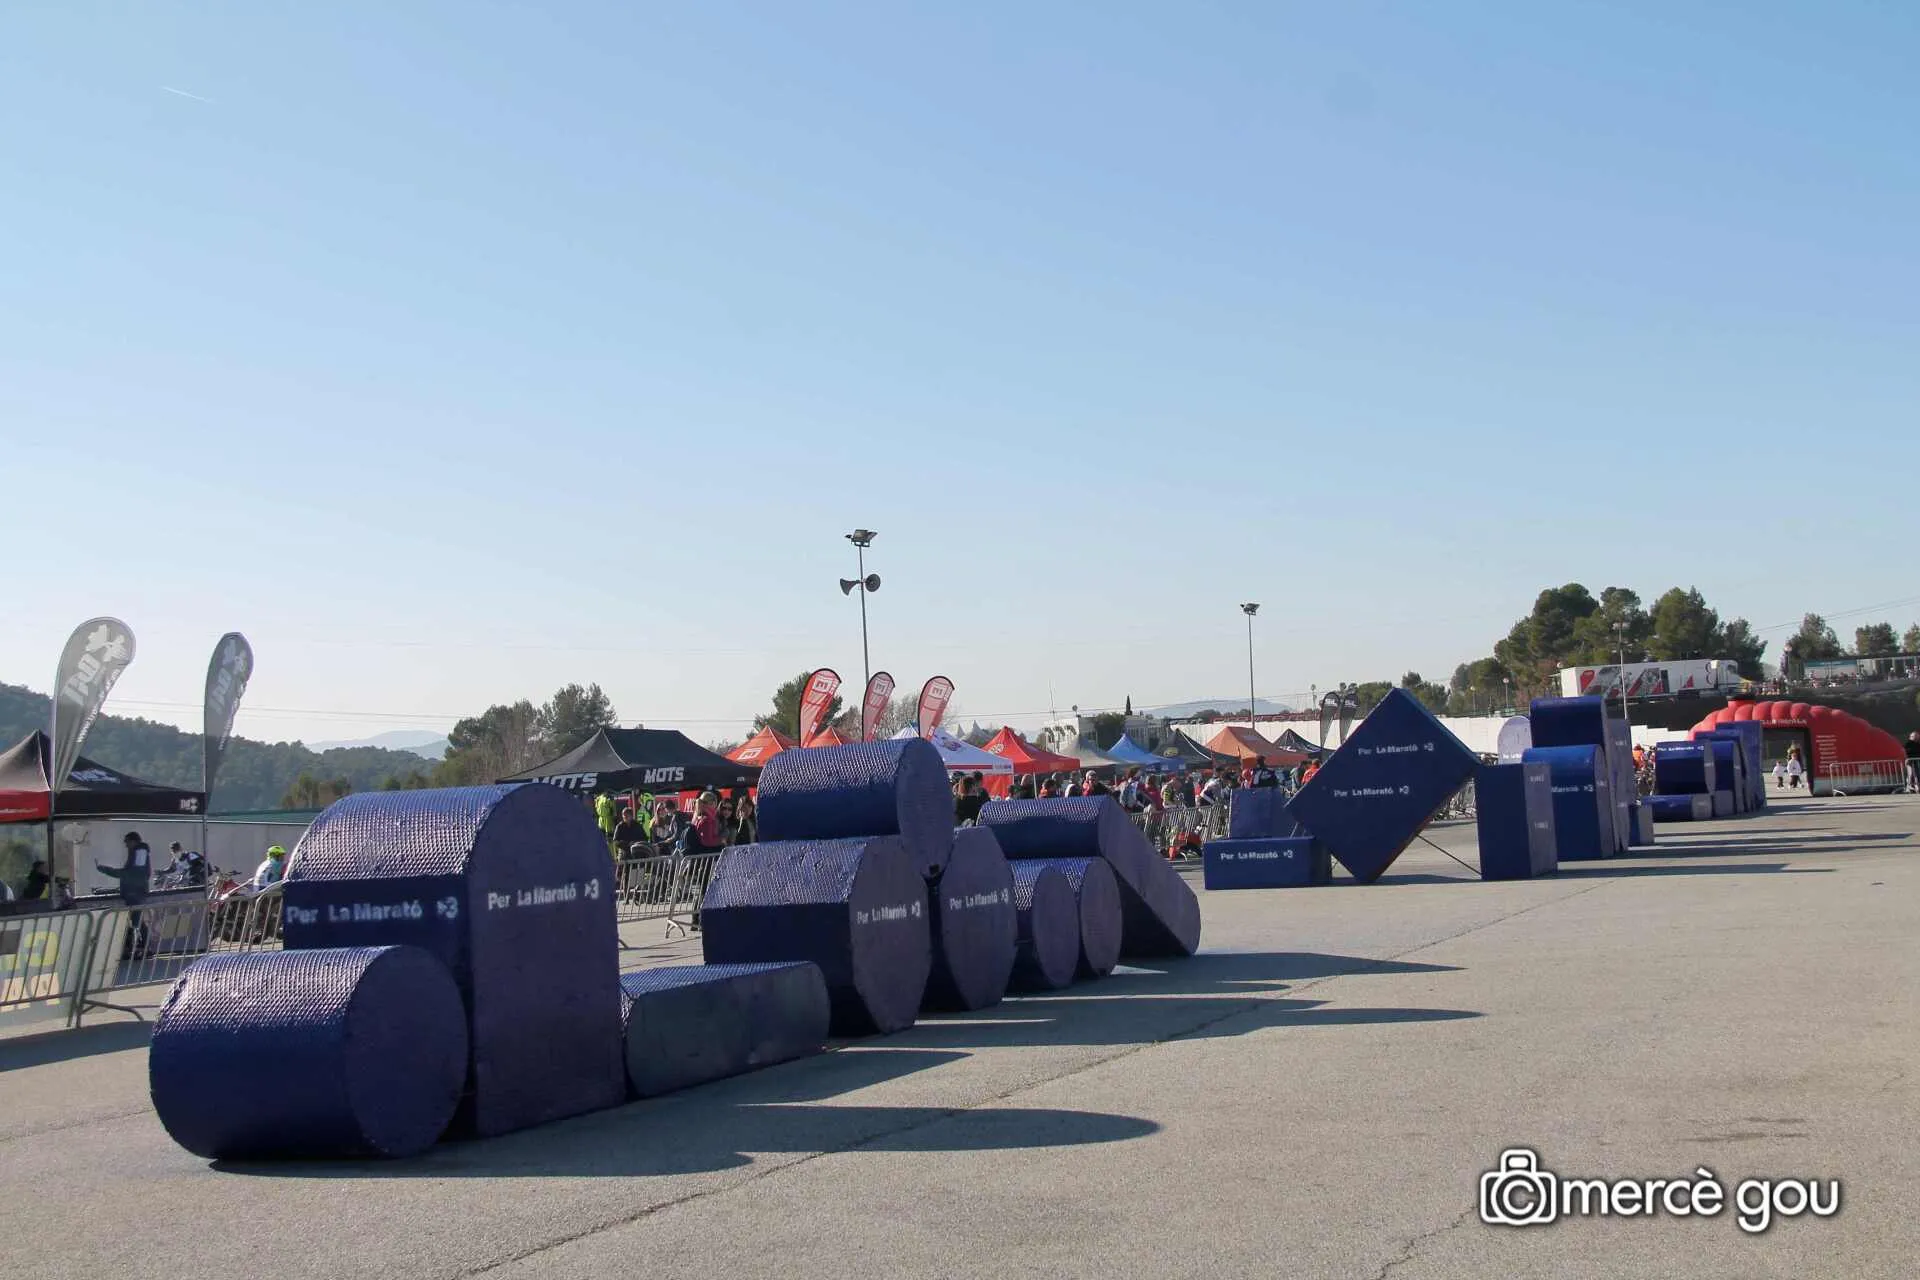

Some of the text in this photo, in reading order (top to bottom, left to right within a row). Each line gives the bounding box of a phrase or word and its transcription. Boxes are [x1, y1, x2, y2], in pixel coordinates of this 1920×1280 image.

[643, 766, 685, 784] MOTS
[487, 892, 511, 911] Per
[286, 905, 319, 924] Per
